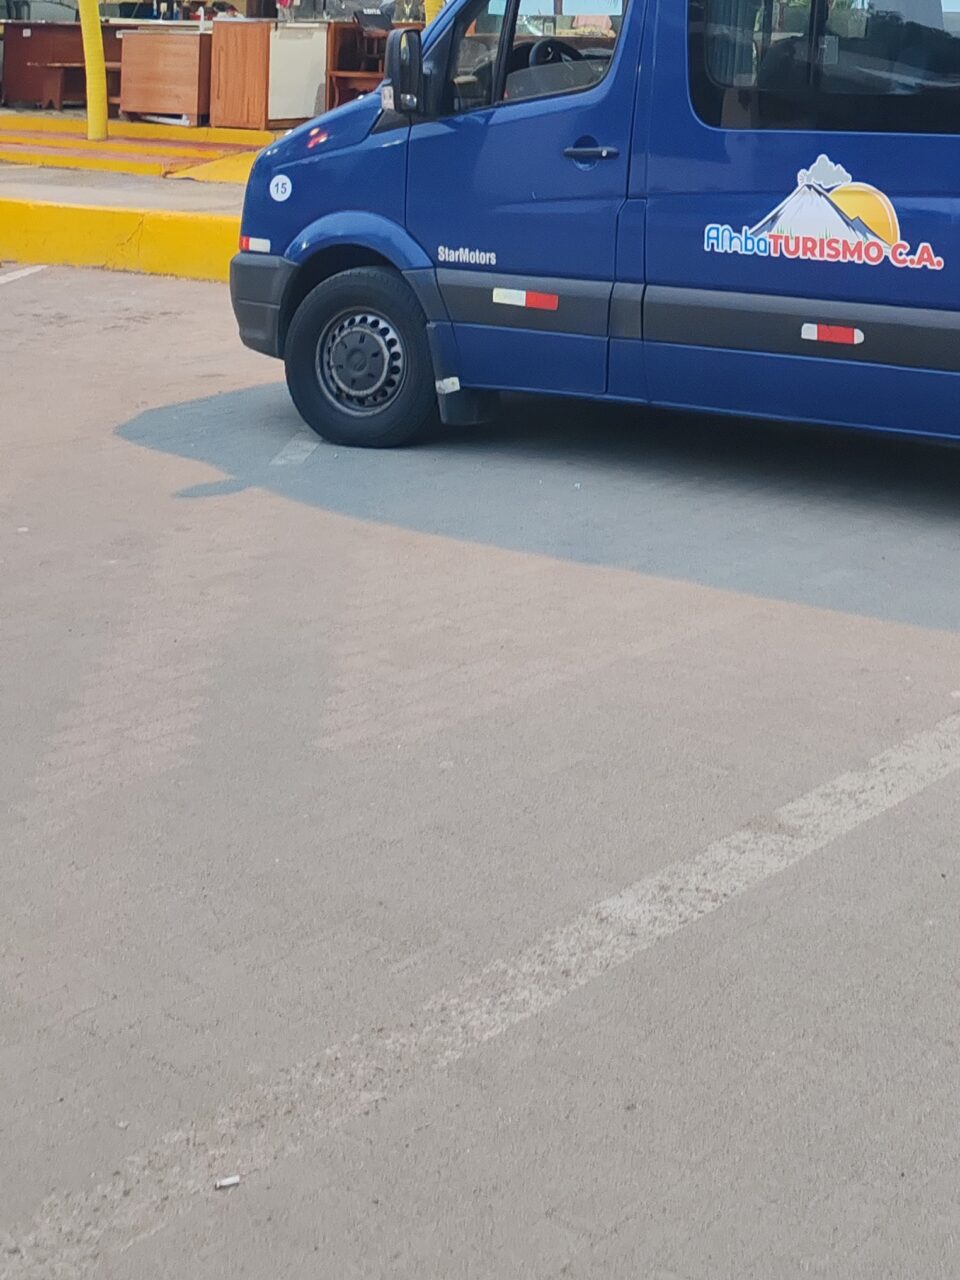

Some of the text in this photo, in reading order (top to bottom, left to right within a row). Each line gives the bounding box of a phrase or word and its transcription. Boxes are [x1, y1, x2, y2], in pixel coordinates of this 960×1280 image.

[274, 181, 288, 195] 15
[437, 245, 497, 266] StarMotors
[889, 241, 945, 270] C.A.
